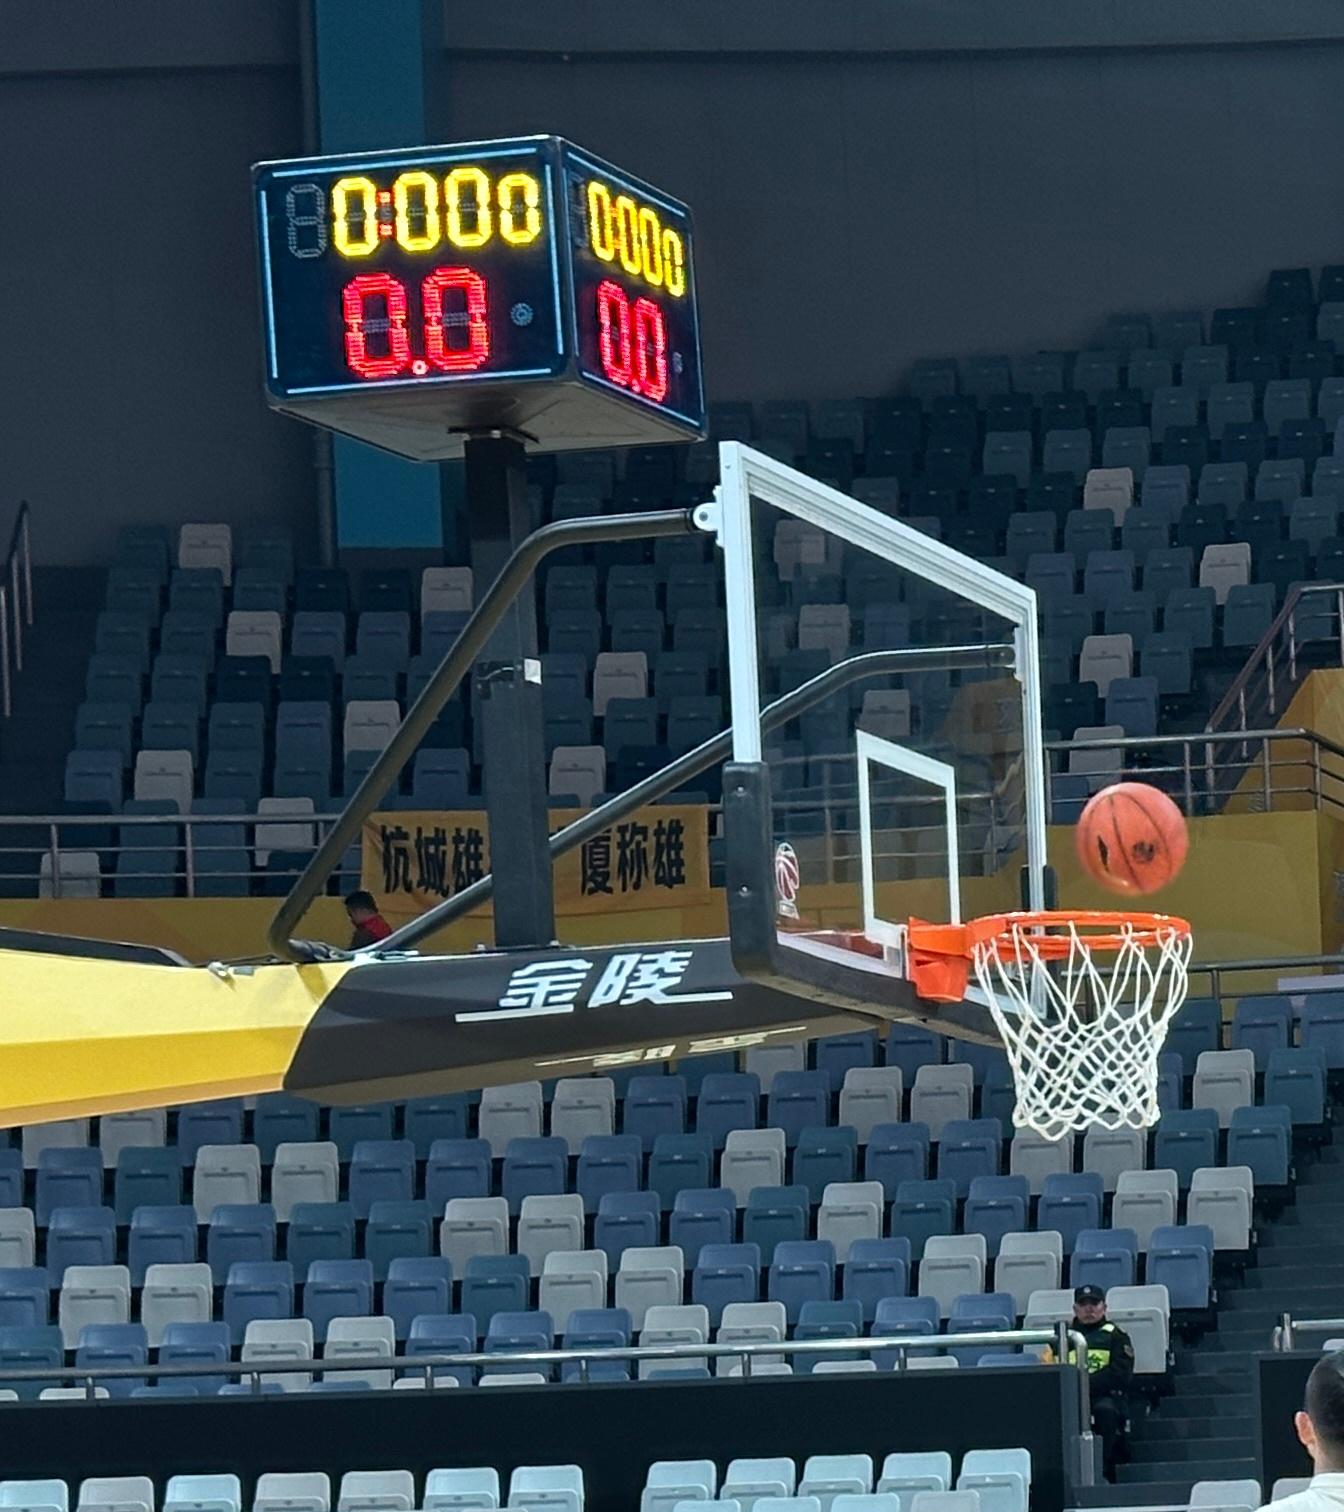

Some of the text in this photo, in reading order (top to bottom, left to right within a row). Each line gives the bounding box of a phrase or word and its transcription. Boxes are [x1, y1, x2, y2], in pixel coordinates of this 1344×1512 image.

[342, 265, 490, 378] 0.0
[598, 279, 668, 402] 0.0
[381, 818, 687, 898] 杭城雄 厦称雄
[455, 951, 734, 1023] 金陵
